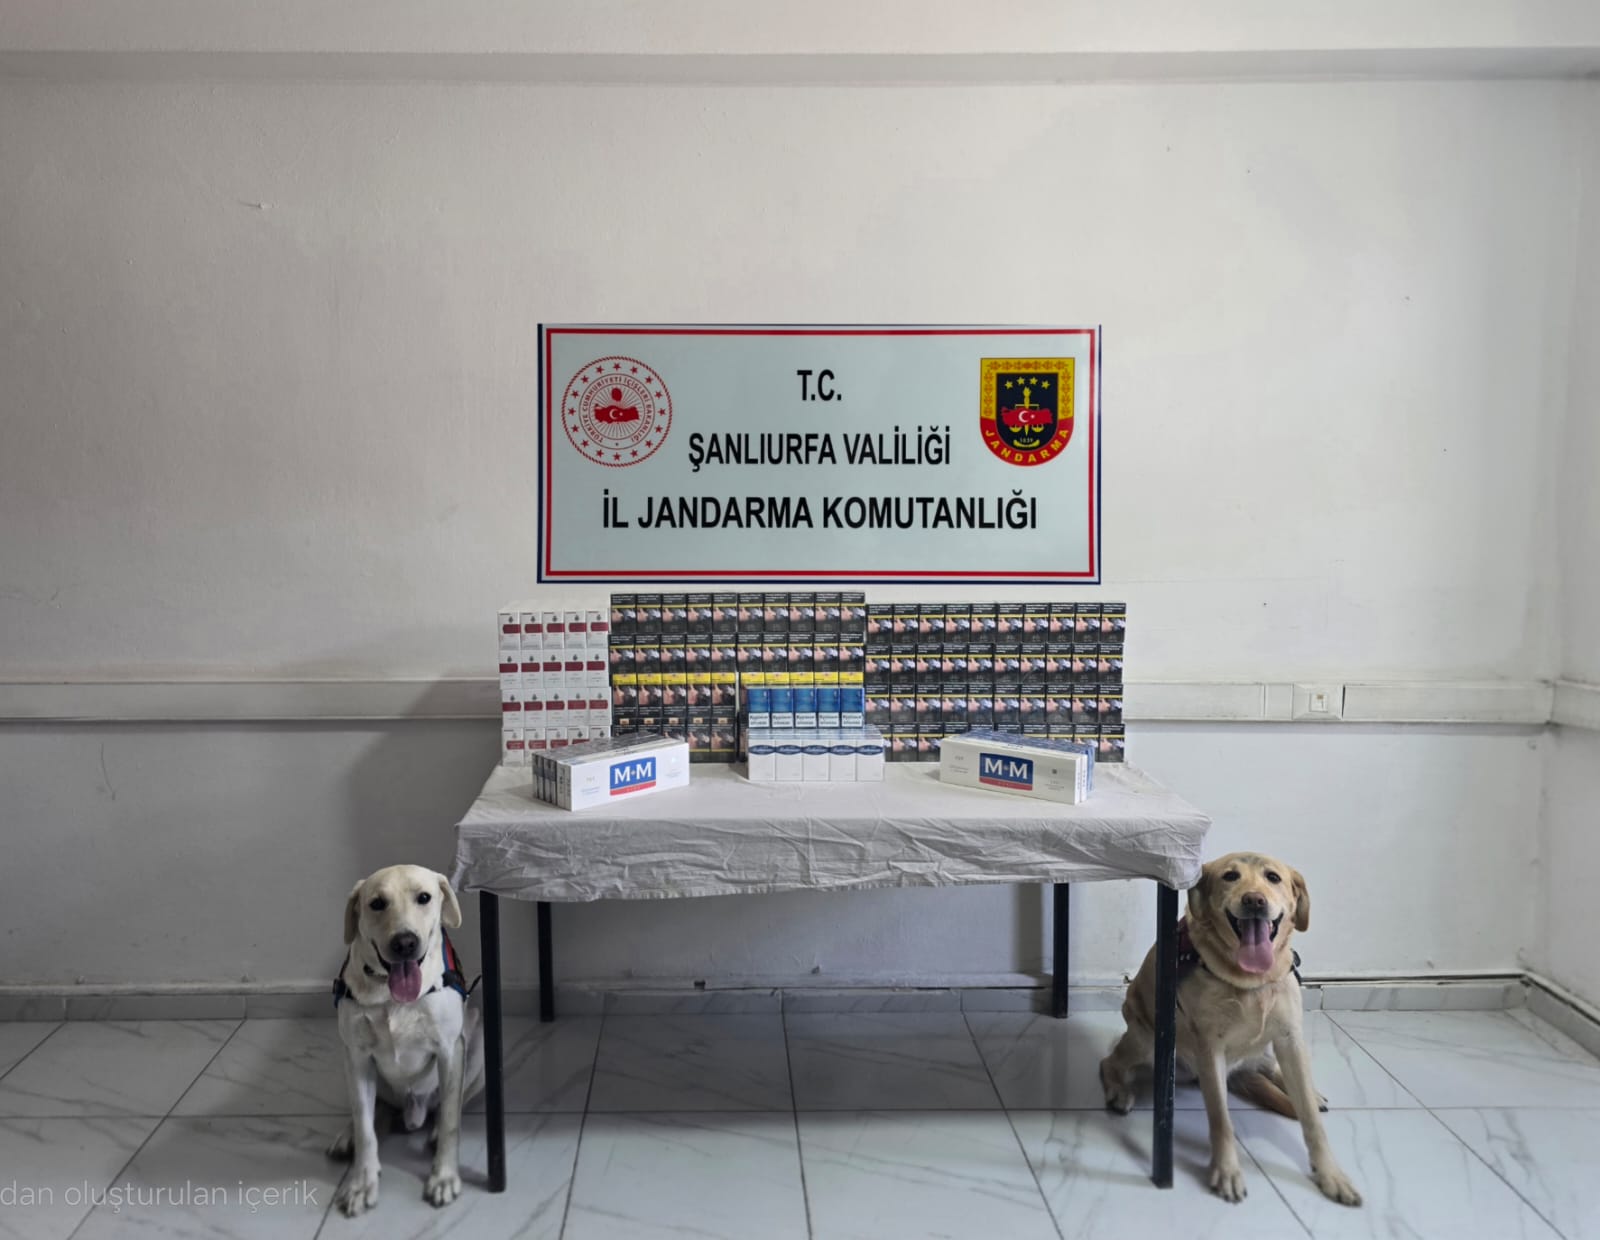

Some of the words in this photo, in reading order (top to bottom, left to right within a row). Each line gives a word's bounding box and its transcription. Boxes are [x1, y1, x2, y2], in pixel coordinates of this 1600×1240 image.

[796, 368, 842, 402] T.C.
[688, 432, 837, 473] ŞANLIURFA
[843, 425, 950, 466] VALİLİĞİ
[985, 429, 1069, 463] JANDARMA
[602, 488, 630, 529] İL
[637, 496, 814, 529] JANDARMA
[823, 489, 1037, 530] KOMUTANLIĞI
